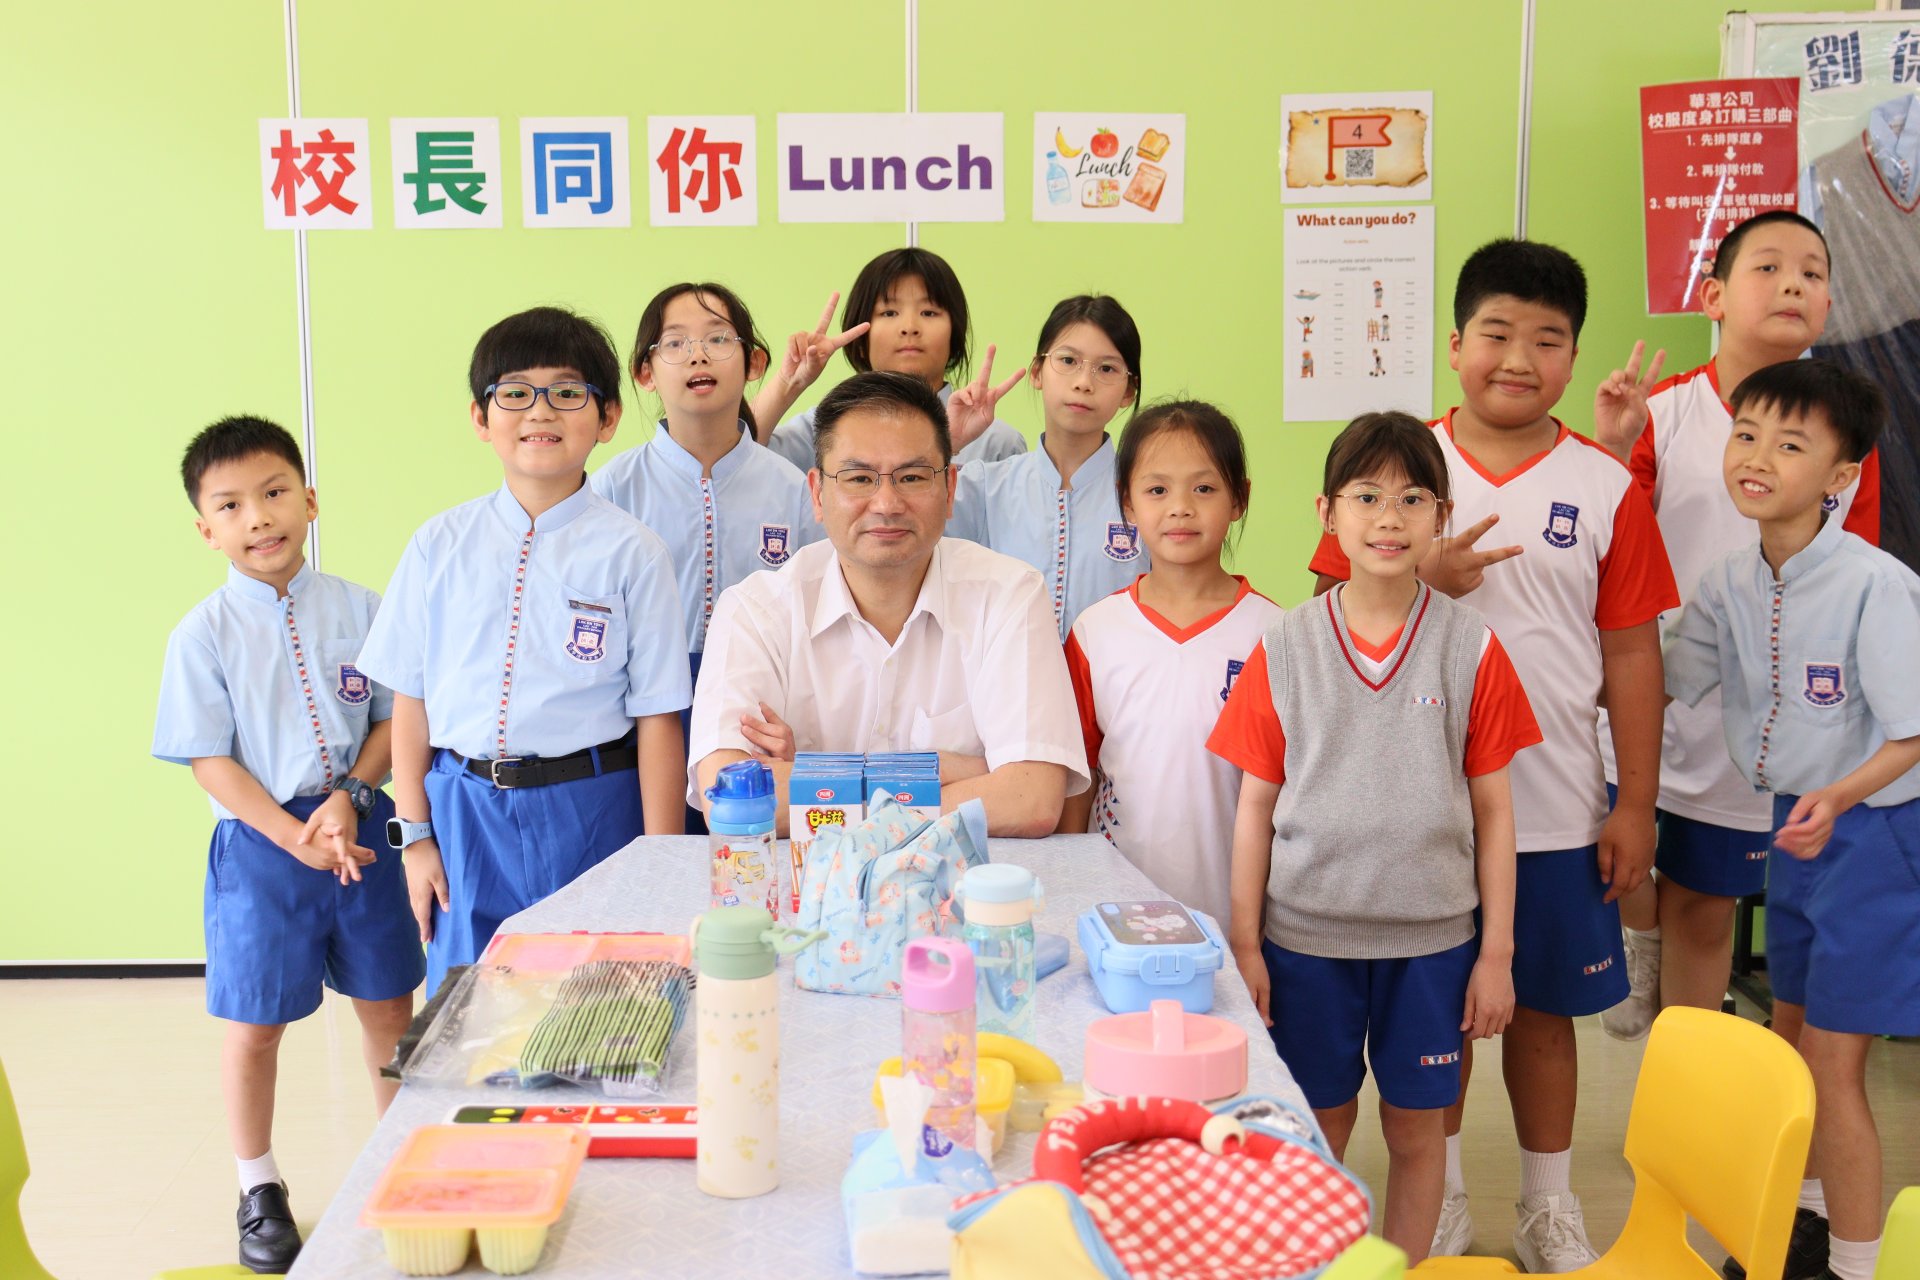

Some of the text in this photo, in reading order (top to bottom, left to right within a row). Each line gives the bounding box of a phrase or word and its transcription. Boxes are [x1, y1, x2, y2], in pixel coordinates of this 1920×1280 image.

[1648, 107, 1793, 129] 校服度身訂購三部曲
[1352, 124, 1363, 139] 4
[1686, 132, 1763, 146] 1. 先排隊度身
[1075, 146, 1134, 178] Lunch
[270, 127, 992, 217] 校長同你 Lunch
[1686, 165, 1697, 177] 2.
[1649, 197, 1661, 209] 3.
[1297, 212, 1416, 229] What can you do?
[1329, 257, 1353, 265] pictures
